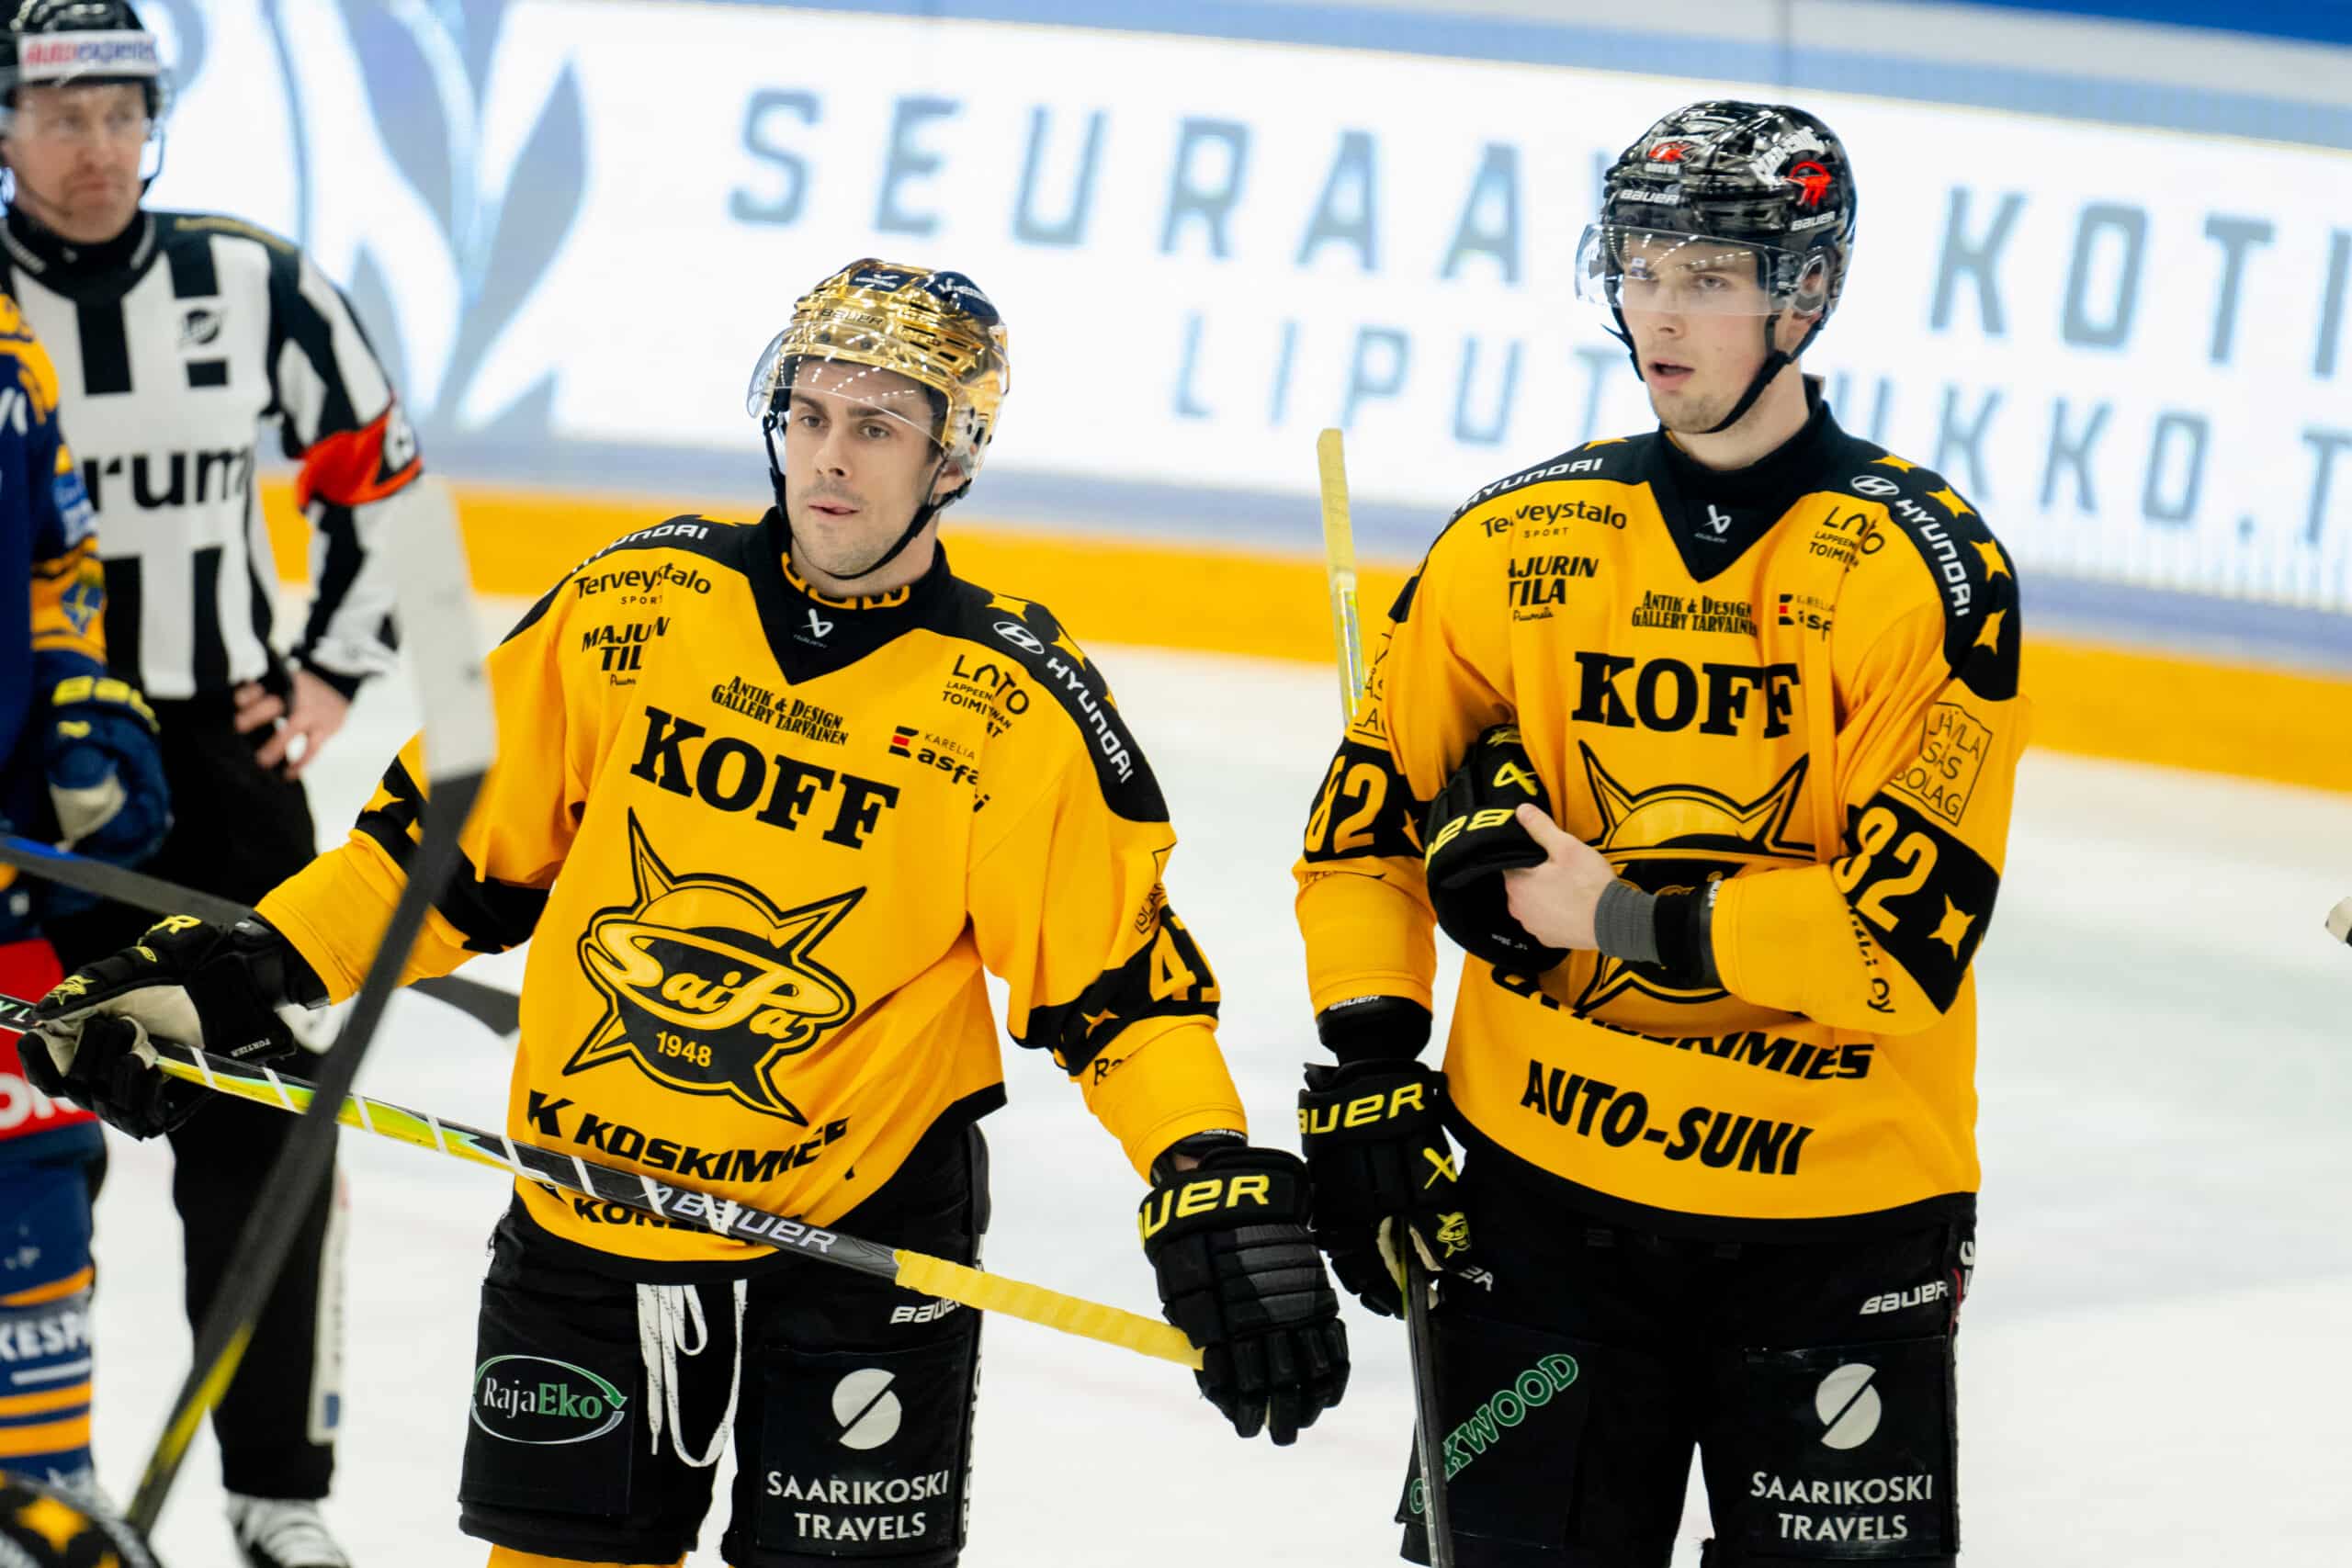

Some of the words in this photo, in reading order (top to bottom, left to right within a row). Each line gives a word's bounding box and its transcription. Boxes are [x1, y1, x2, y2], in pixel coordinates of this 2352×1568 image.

[726, 87, 1613, 289] SEURAA
[1832, 367, 2352, 549] UKKO.T
[574, 562, 711, 600] Terveystalo
[1895, 499, 1971, 617] HYUNDAI
[1632, 607, 1687, 630] GALLERY
[600, 644, 643, 671] TIL
[711, 684, 775, 725] GALLERY
[775, 713, 849, 746] TARVAINEN
[727, 676, 774, 706] ANTIK
[775, 697, 787, 713] &
[789, 699, 843, 729] DESIGN
[1046, 656, 1136, 784] HYUNDAI
[1571, 650, 1801, 739] KOFF
[924, 733, 977, 761] KARELIA
[630, 705, 899, 850] KOFF
[1833, 806, 1939, 932] 82
[656, 1029, 713, 1068] 1948
[1297, 1082, 1425, 1135] AUER
[1520, 1058, 1815, 1176] AUTO-SUNI
[1859, 1280, 1949, 1315] BAUER
[482, 1376, 604, 1421] RajaEko
[1409, 1353, 1578, 1514] OKWOOD
[766, 1469, 949, 1506] SAARIKOSKI
[1750, 1472, 1934, 1506] SAARIKOSKI
[794, 1511, 927, 1541] TRAVELS
[1778, 1514, 1908, 1543] TRAVELS
